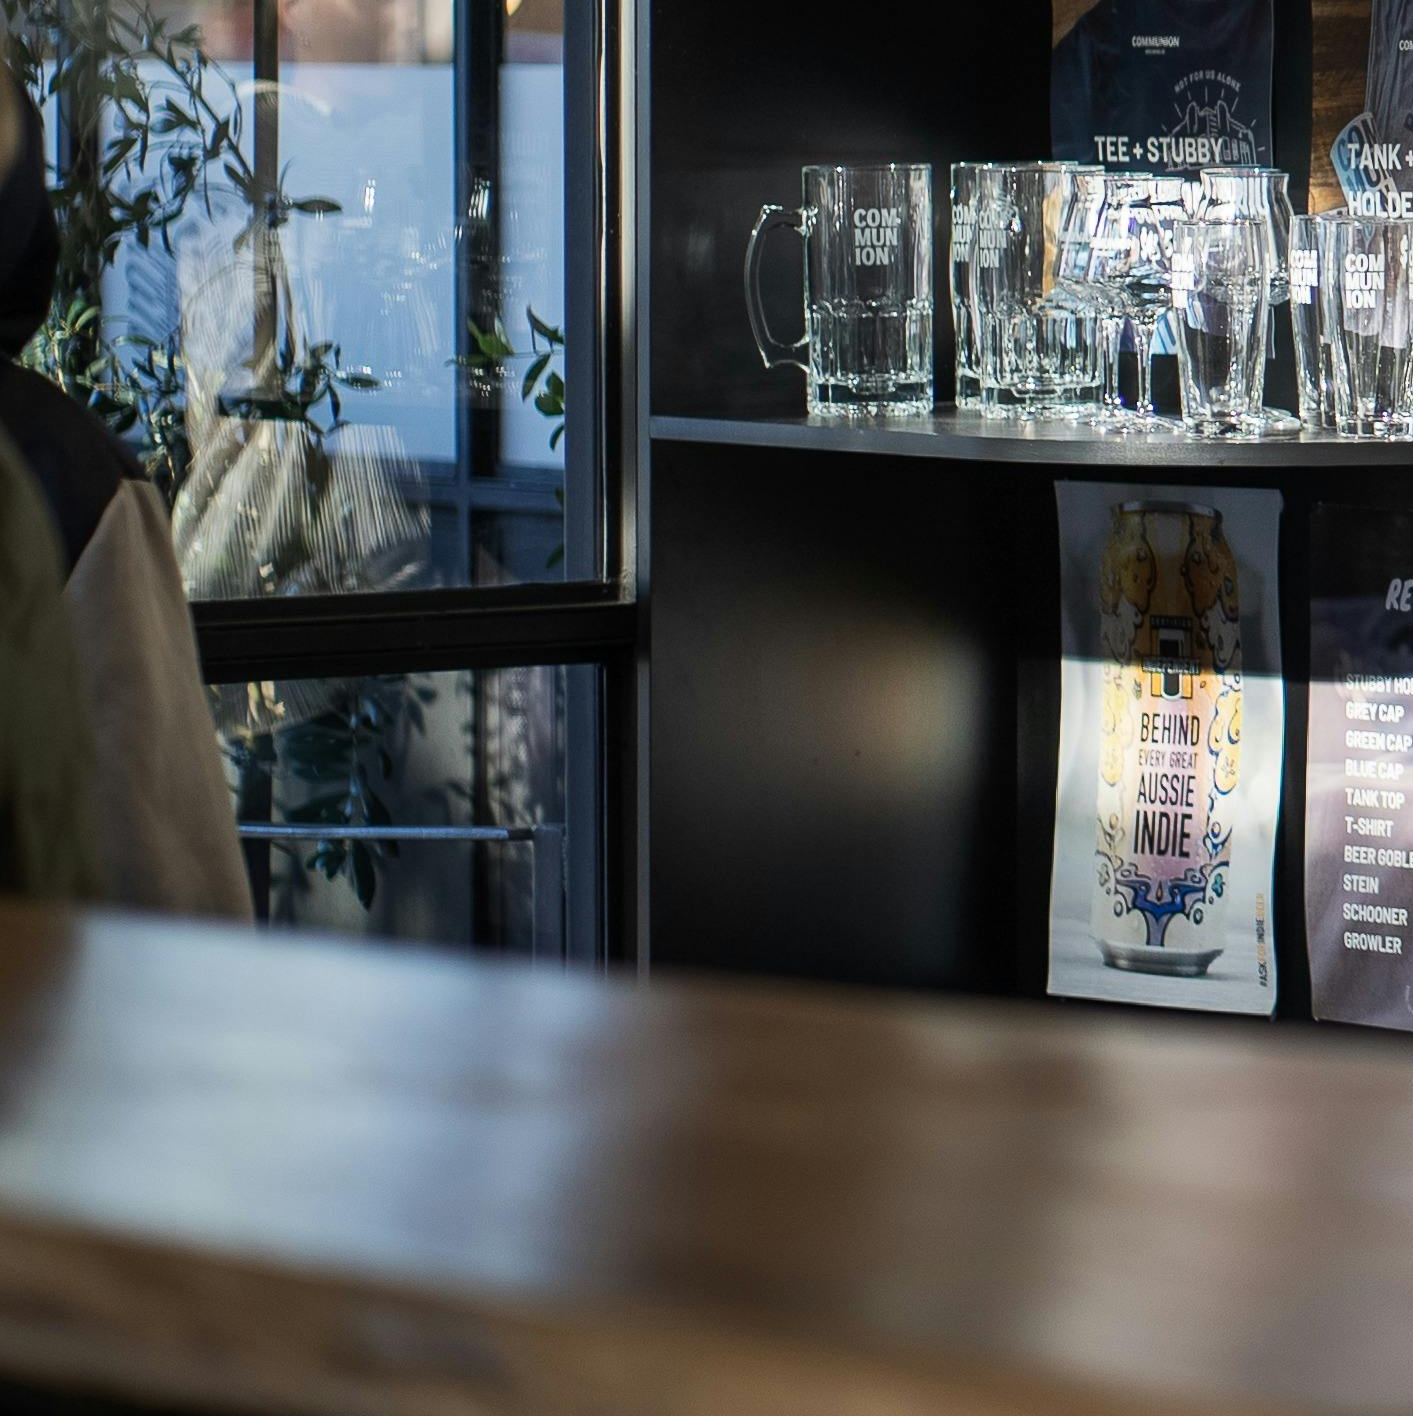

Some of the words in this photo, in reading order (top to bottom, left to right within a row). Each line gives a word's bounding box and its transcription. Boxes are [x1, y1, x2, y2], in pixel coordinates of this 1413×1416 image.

[1094, 136, 1131, 163] TEE
[1133, 142, 1144, 159] +
[1147, 137, 1223, 164] STUBBY
[1347, 143, 1402, 171] TANK
[853, 208, 898, 227] COM
[854, 228, 897, 246] MUN
[979, 230, 1007, 248] MUN
[855, 247, 889, 266] ION
[980, 249, 999, 268] ION
[1345, 253, 1385, 272] COM
[1345, 272, 1385, 290] MUN
[1345, 290, 1377, 309] ION
[1345, 673, 1391, 694] STUBBY
[1345, 701, 1378, 722] GREY
[1378, 704, 1405, 723] CAP
[1140, 712, 1200, 746] BEHIND
[1345, 730, 1387, 751] GREEN
[1387, 733, 1412, 753] CAP
[1138, 748, 1166, 767] EVERY
[1169, 749, 1198, 769] GREAT
[1345, 758, 1377, 779] BLUE
[1377, 761, 1404, 781] CAP
[1137, 773, 1196, 808] AUSSIE
[1345, 787, 1381, 807] TANK
[1381, 790, 1405, 810] TOP
[1133, 808, 1190, 859] INDIE
[1345, 816, 1394, 838] T-SHIRT
[1344, 845, 1376, 865] BEER
[1343, 874, 1379, 894] STEIN
[1343, 903, 1408, 926] SCHOONER
[1344, 932, 1402, 954] GROWLER
